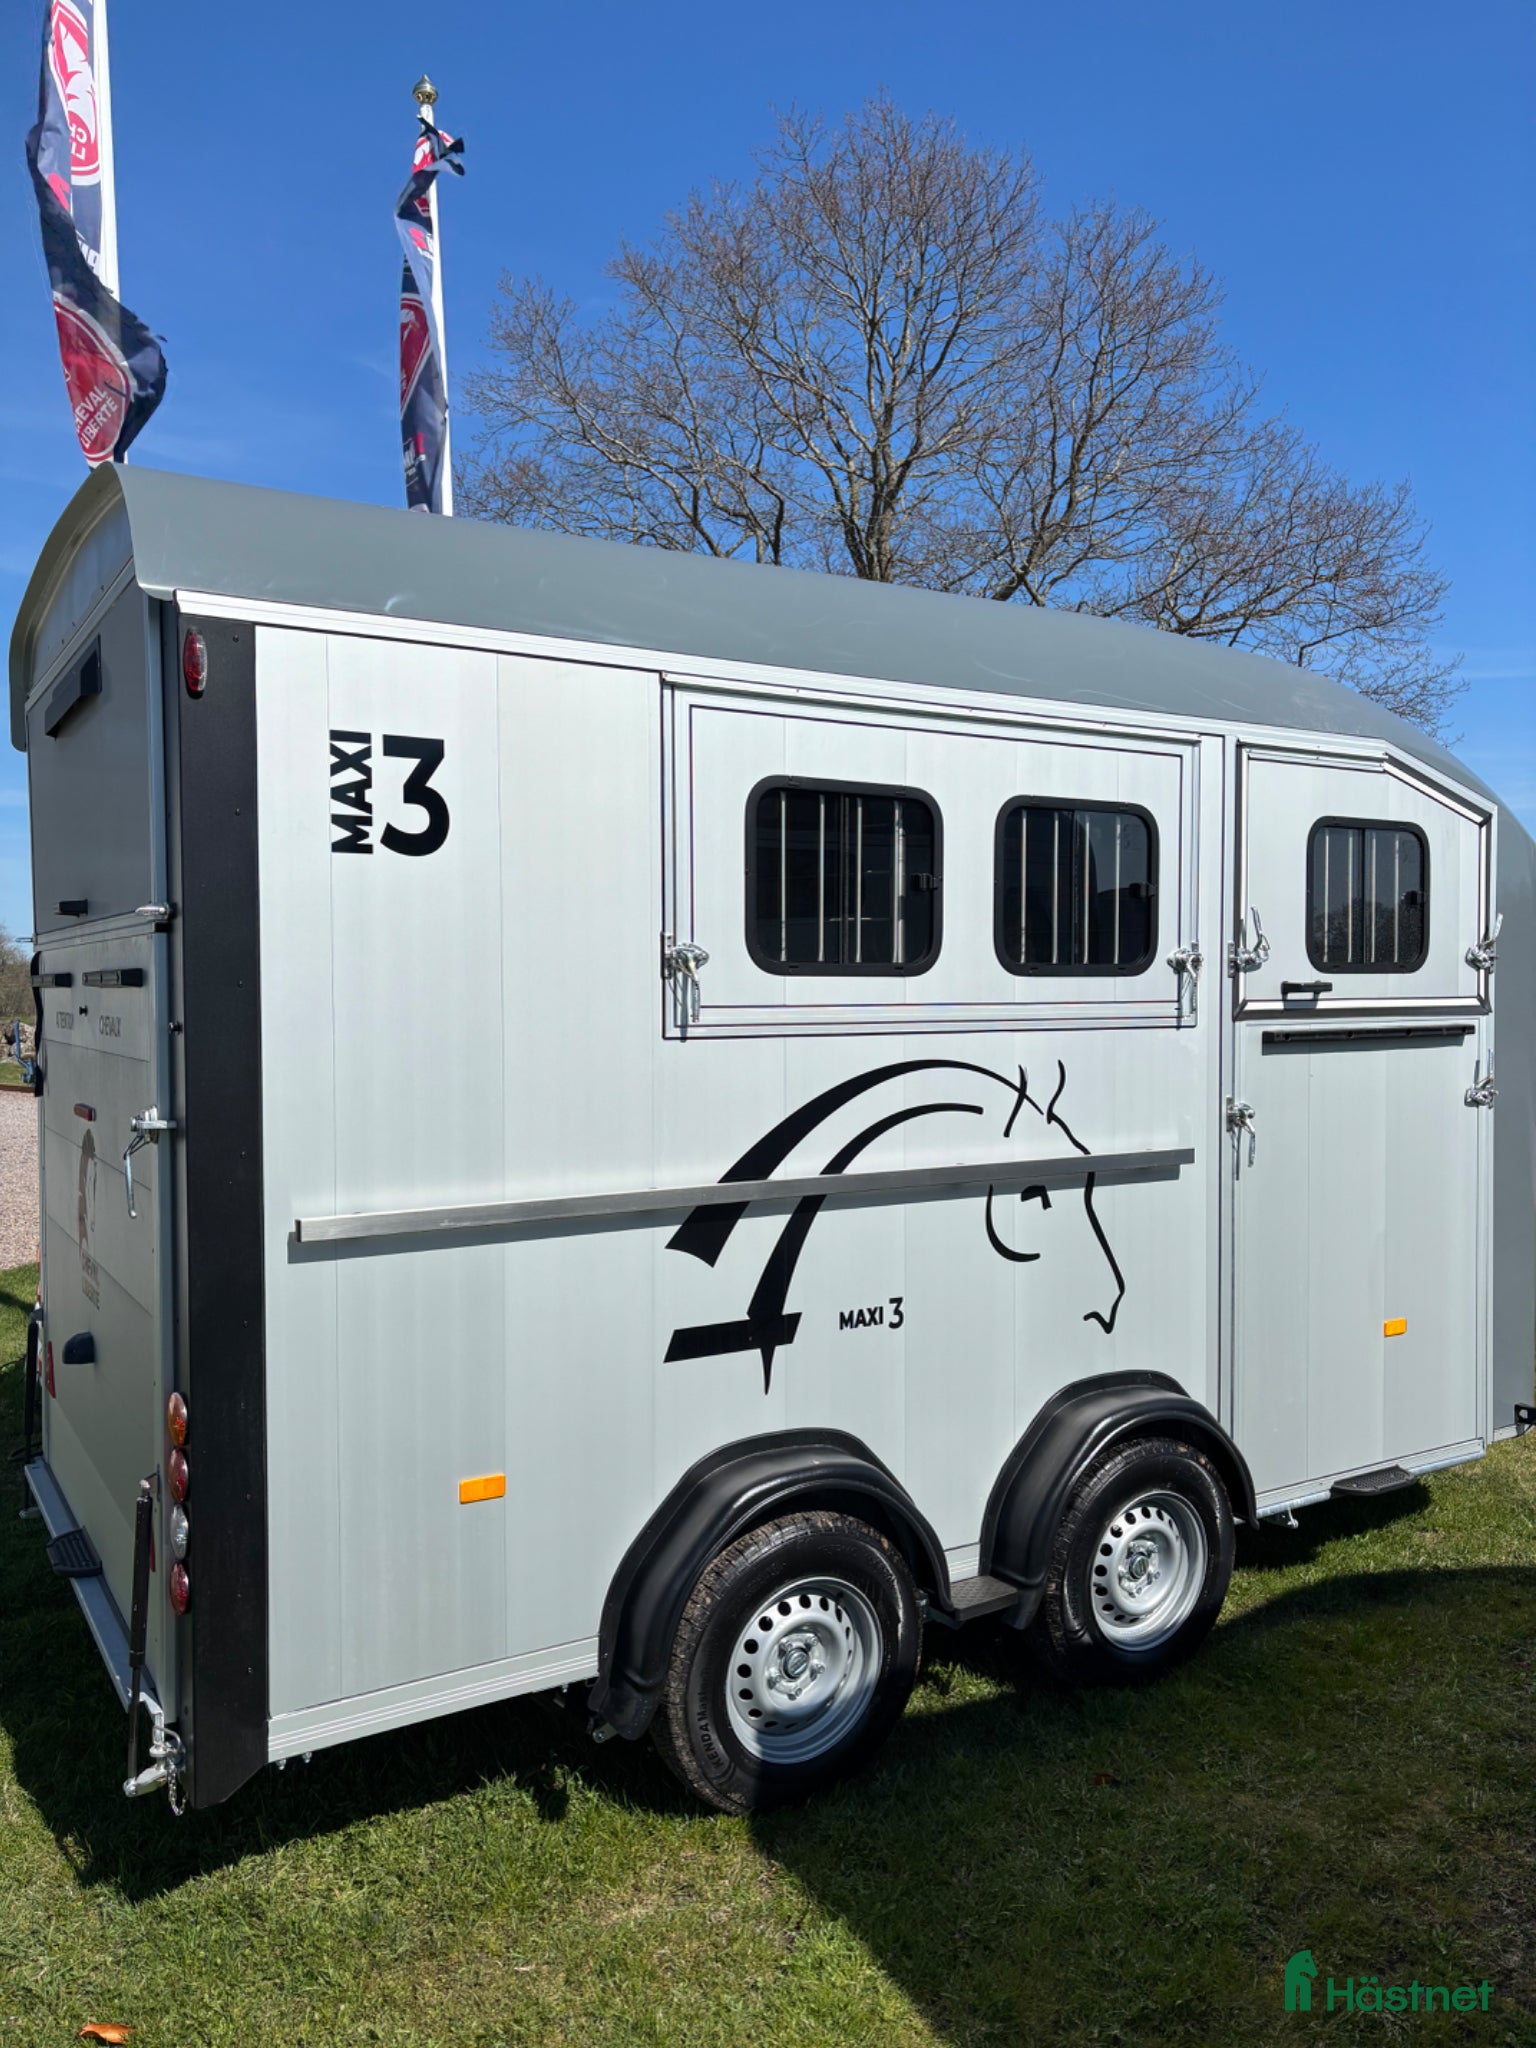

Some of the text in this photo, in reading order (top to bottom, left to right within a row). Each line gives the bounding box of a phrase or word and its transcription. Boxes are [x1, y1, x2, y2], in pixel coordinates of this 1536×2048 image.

[329, 729, 450, 857] MAXI 3
[839, 1296, 904, 1331] MAXI 3
[699, 1722, 724, 1769] KENDA
